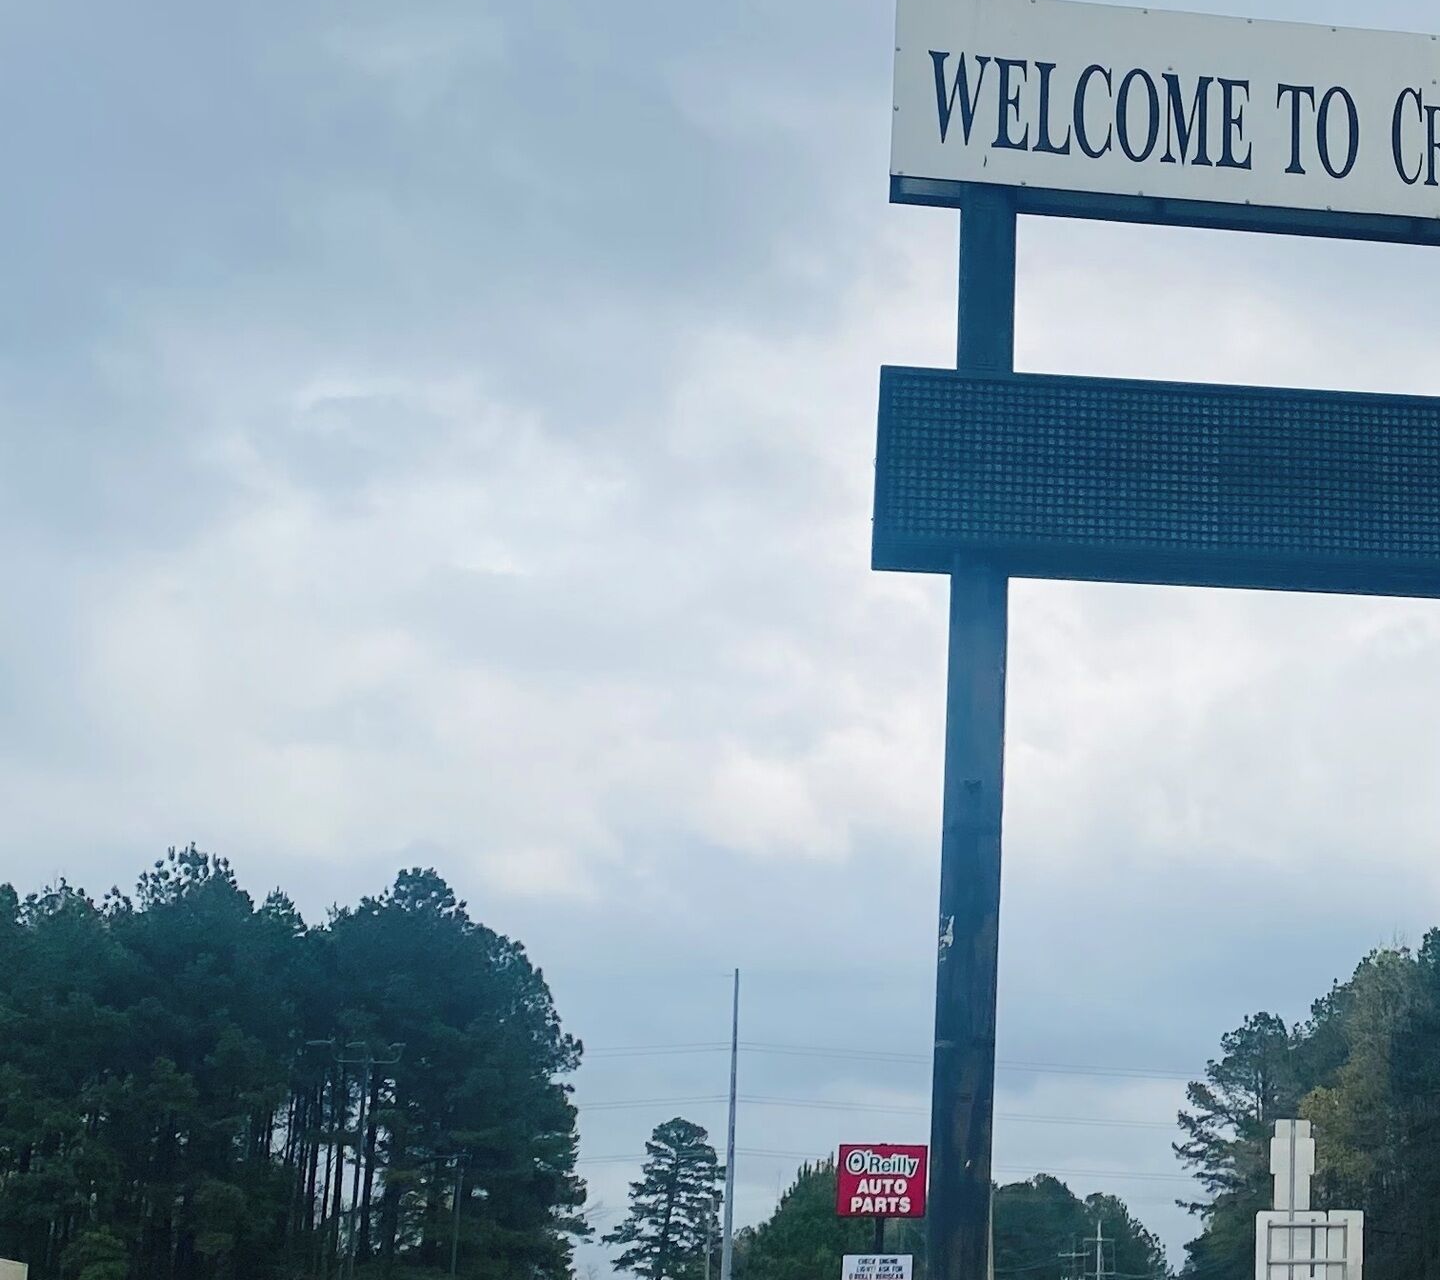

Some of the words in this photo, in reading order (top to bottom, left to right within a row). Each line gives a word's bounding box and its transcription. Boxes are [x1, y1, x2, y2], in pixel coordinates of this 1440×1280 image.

[928, 49, 1252, 170] WELCOME
[1276, 83, 1359, 180] TO
[847, 1150, 917, 1177] O'Reilly
[856, 1178, 908, 1195] AUTO
[850, 1196, 911, 1214] PARTS
